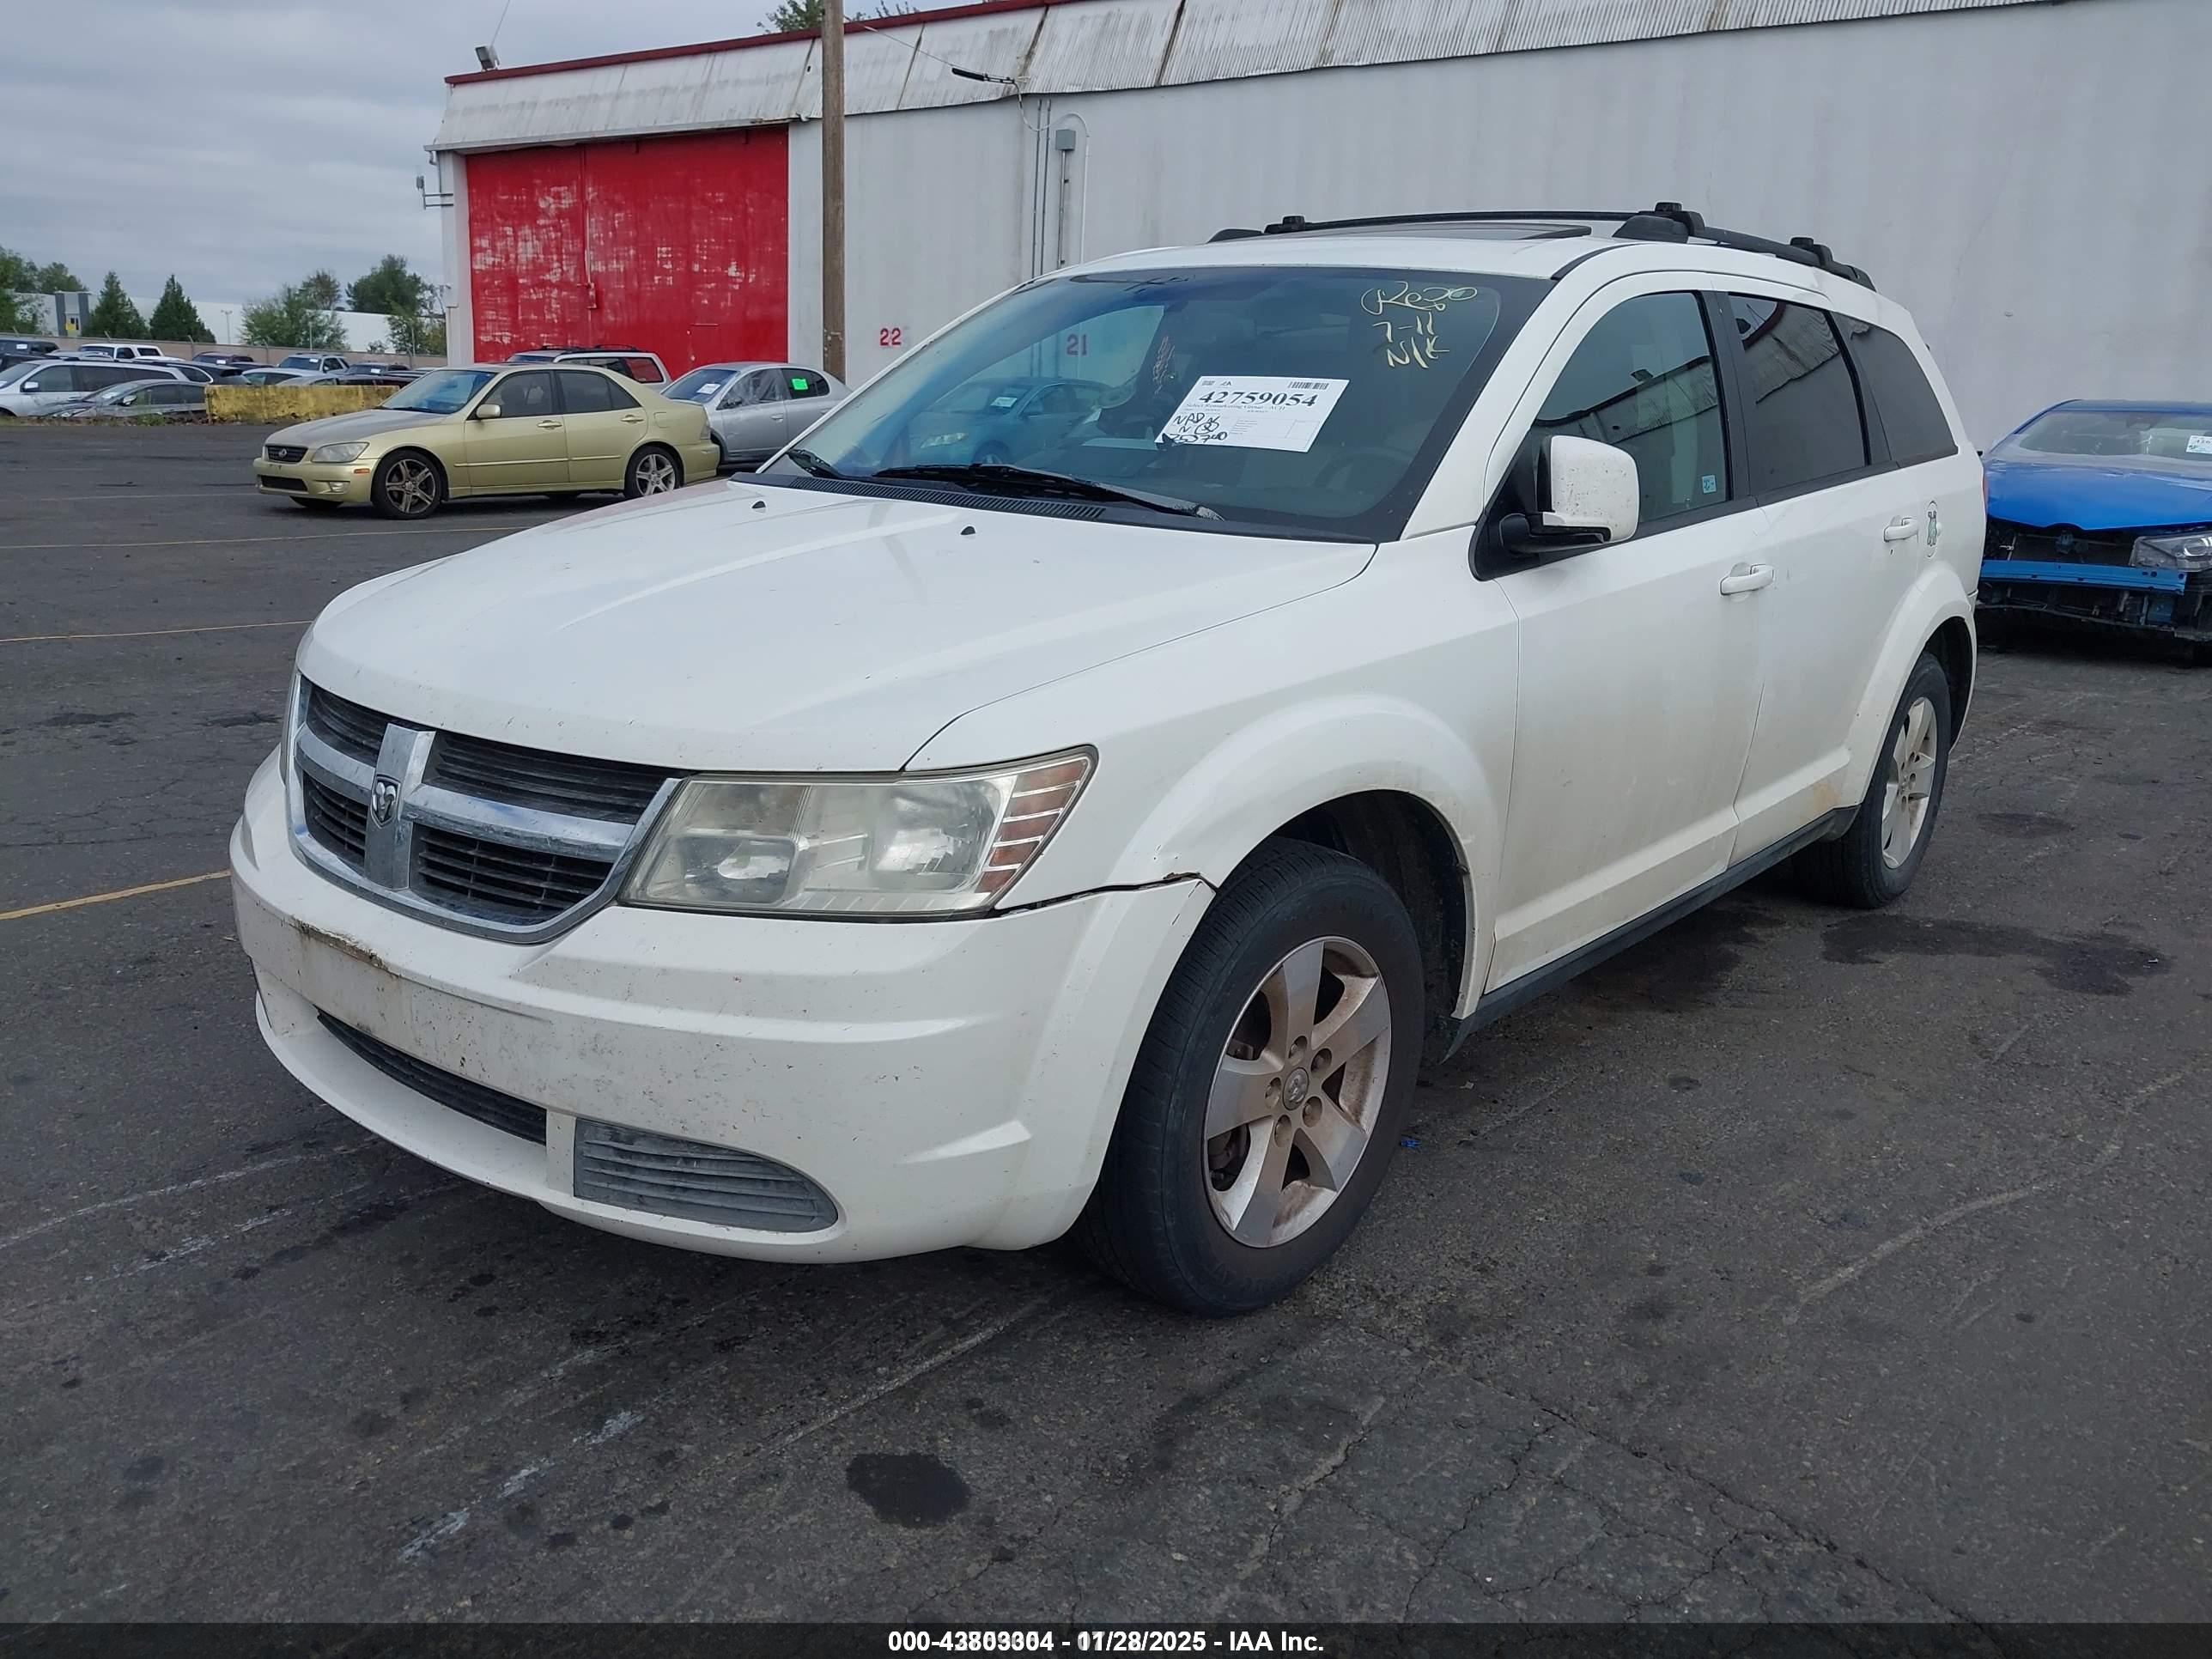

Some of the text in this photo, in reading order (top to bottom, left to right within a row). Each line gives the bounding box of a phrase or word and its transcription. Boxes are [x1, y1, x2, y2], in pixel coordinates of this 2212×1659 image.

[879, 327, 902, 345] 22
[1066, 334, 1087, 356] 21
[1199, 391, 1319, 407] 42759054
